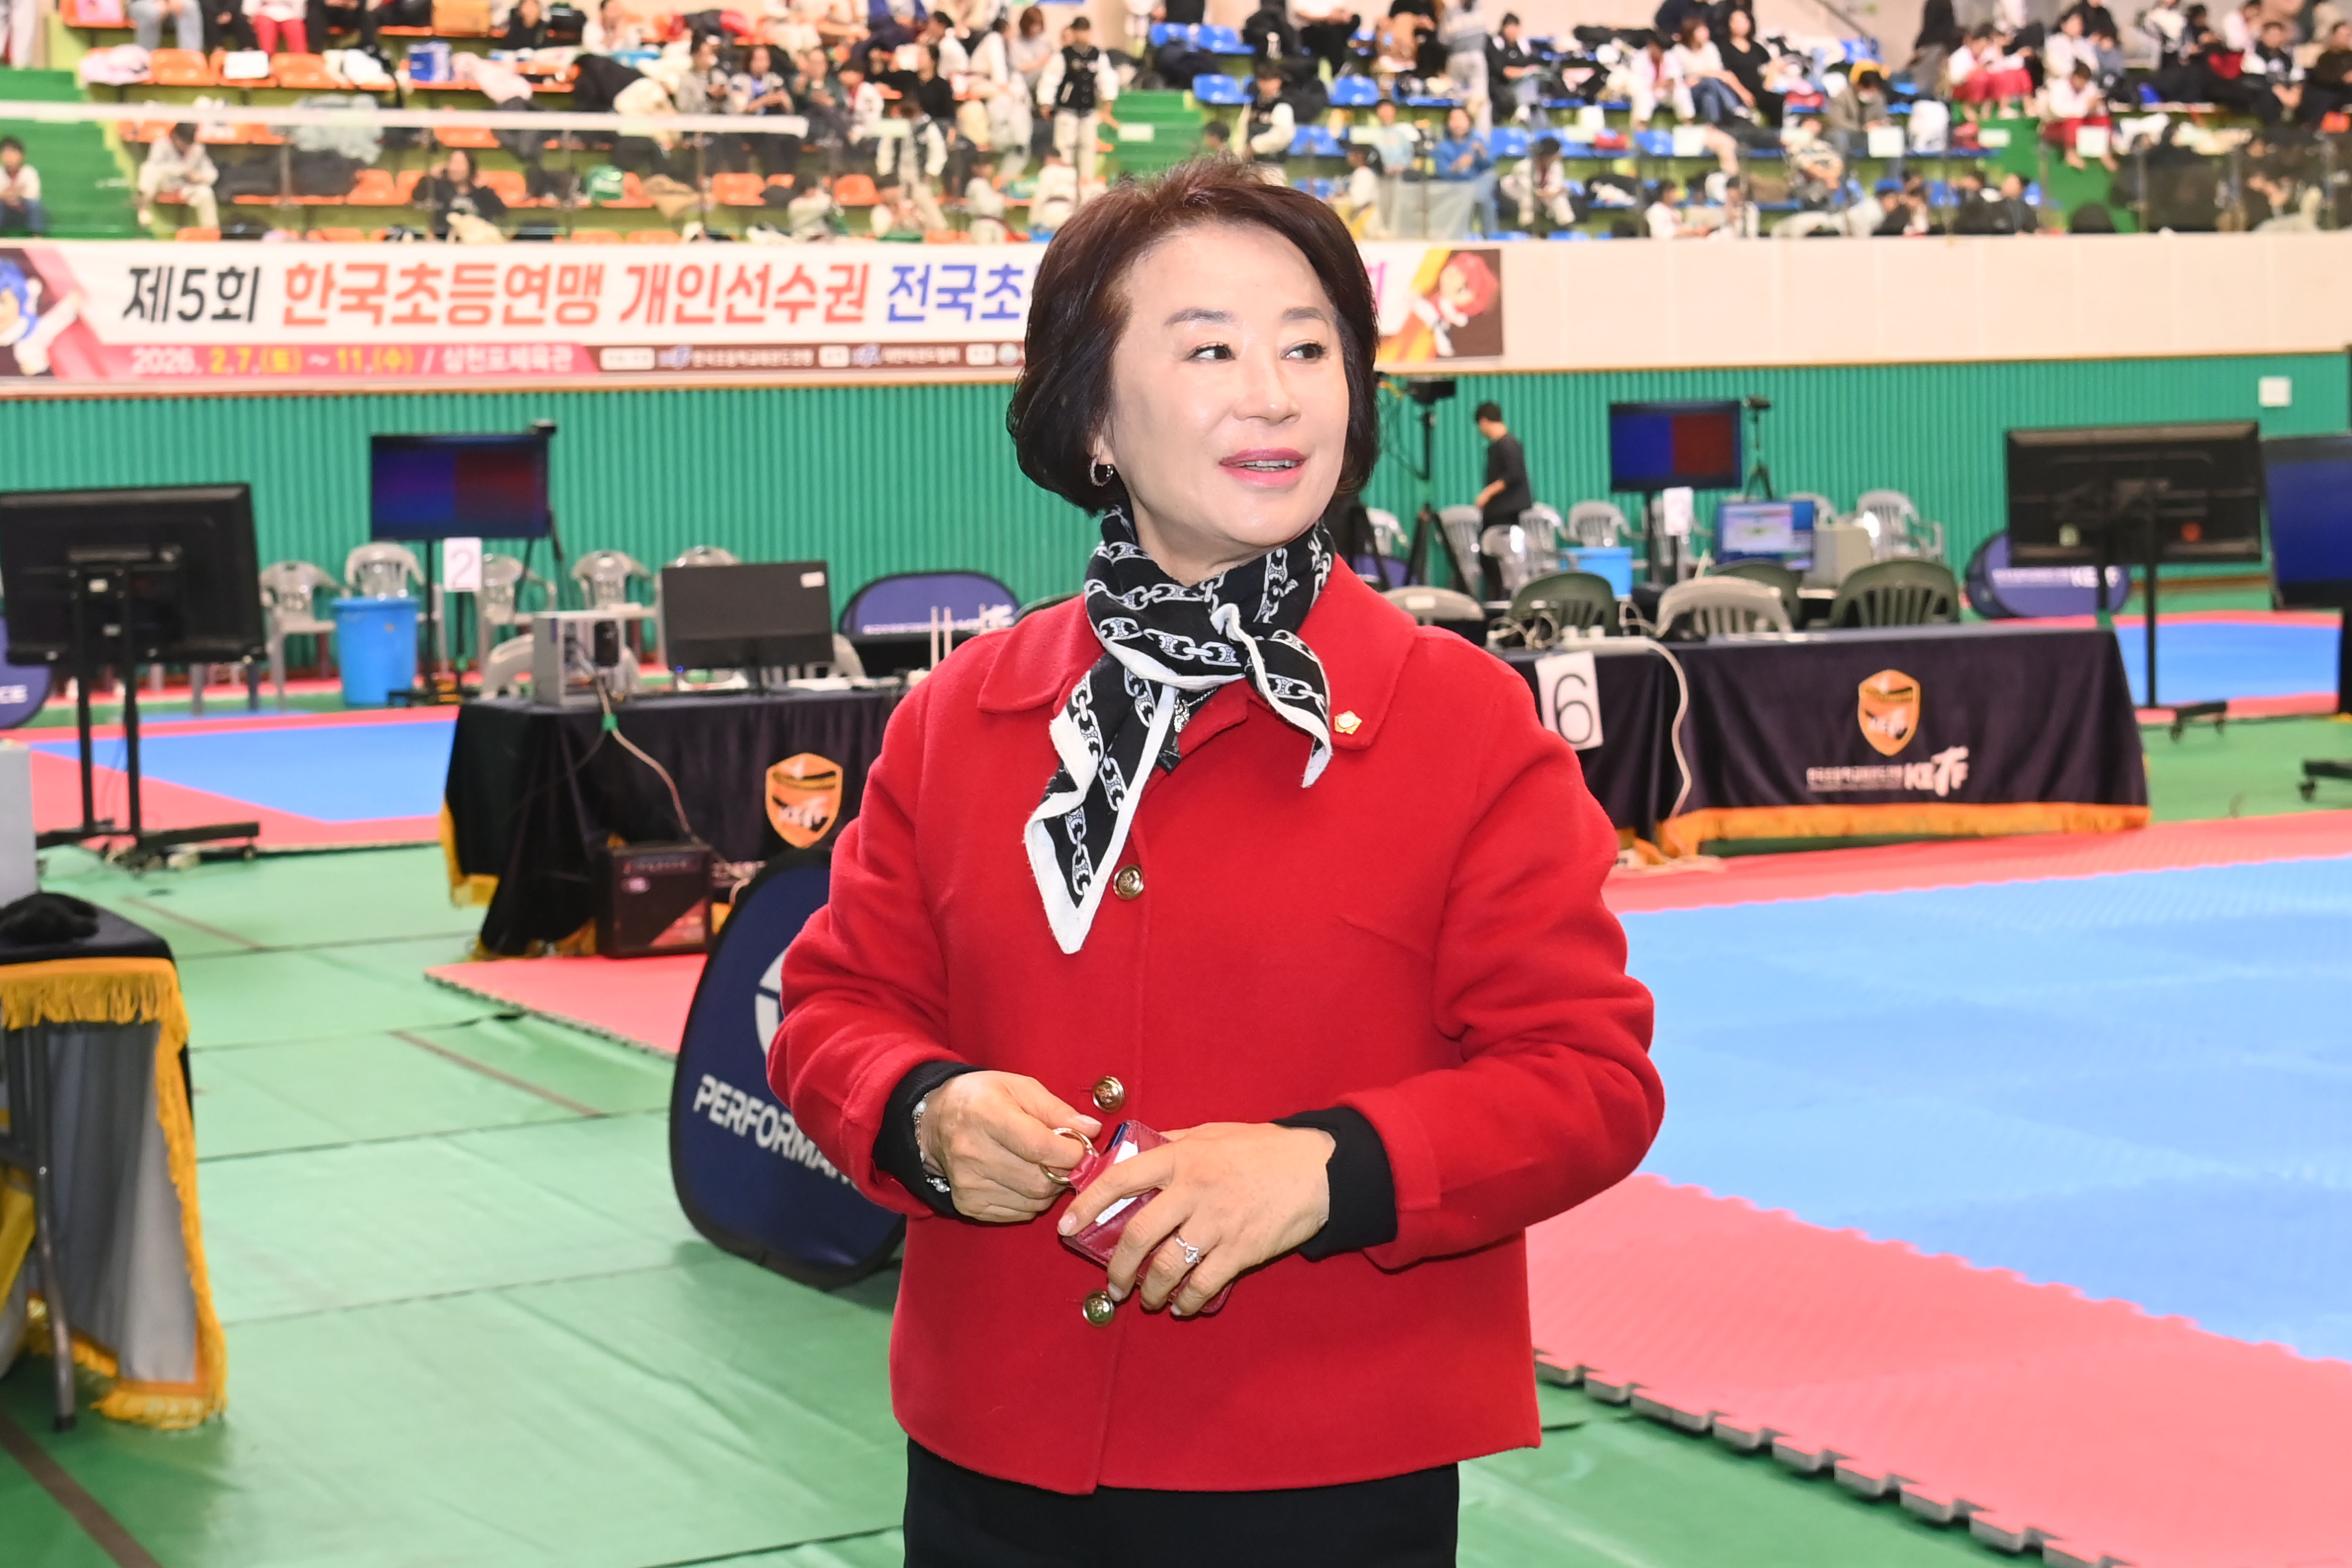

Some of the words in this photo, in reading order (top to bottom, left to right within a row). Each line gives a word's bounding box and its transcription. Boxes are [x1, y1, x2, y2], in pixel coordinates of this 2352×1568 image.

[122, 266, 260, 323] 제5회
[282, 262, 605, 327] 한국초등연맹
[619, 263, 870, 324] 개인선수권
[887, 263, 1041, 323] 전국초
[451, 547, 474, 591] 2
[1554, 672, 1593, 744] 6
[692, 1073, 859, 1190] PERFORMA
